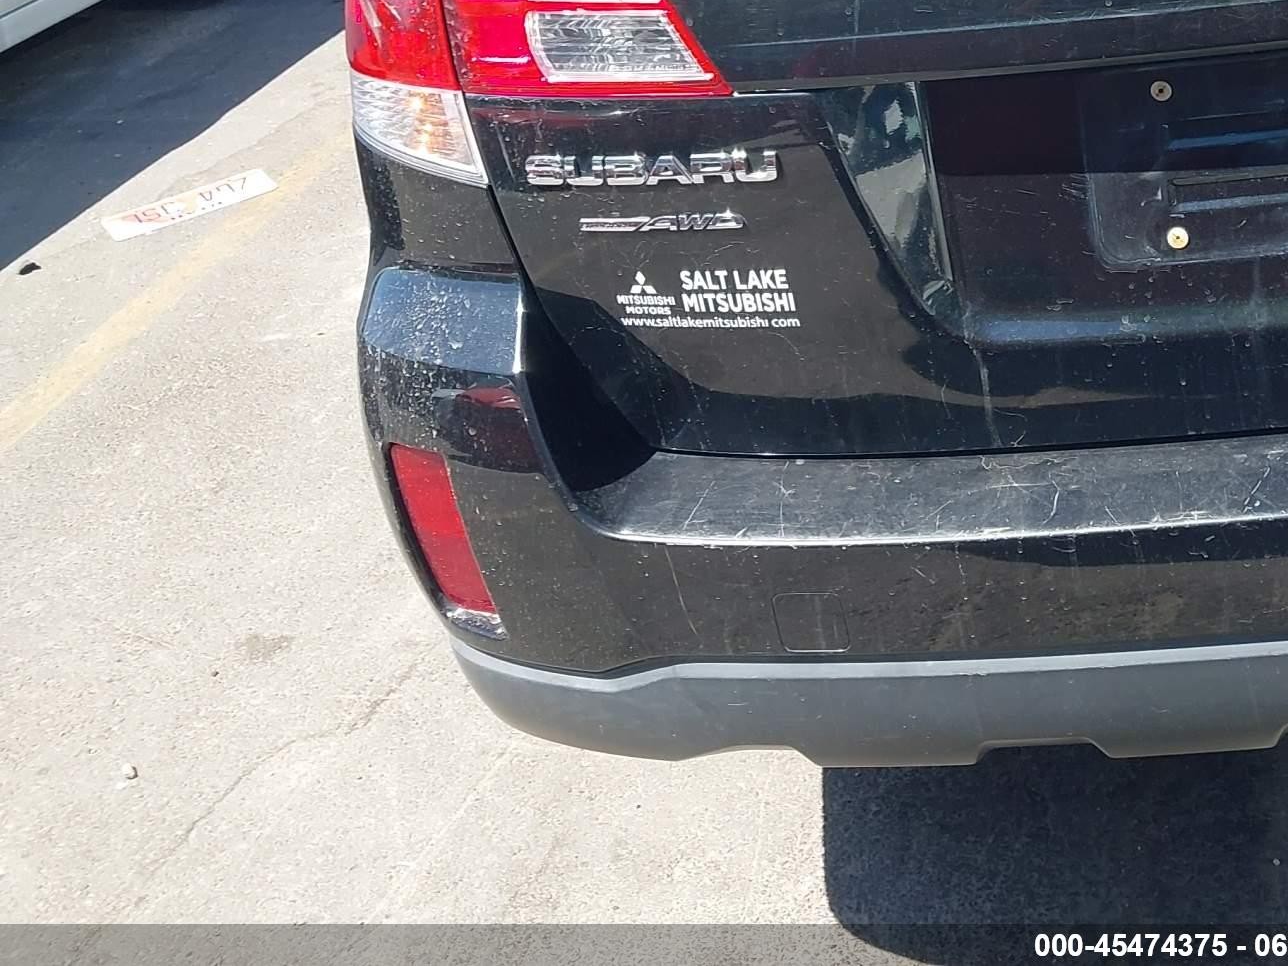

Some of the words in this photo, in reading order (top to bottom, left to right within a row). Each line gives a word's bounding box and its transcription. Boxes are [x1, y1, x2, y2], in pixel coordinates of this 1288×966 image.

[524, 148, 778, 186] SUBARU
[640, 212, 745, 232] AWD
[680, 270, 727, 291] SALT
[733, 269, 789, 290] LAKE
[616, 295, 676, 306] MITSUBISHI
[625, 306, 671, 315] MOTORS
[681, 292, 796, 313] MITSUBISHI
